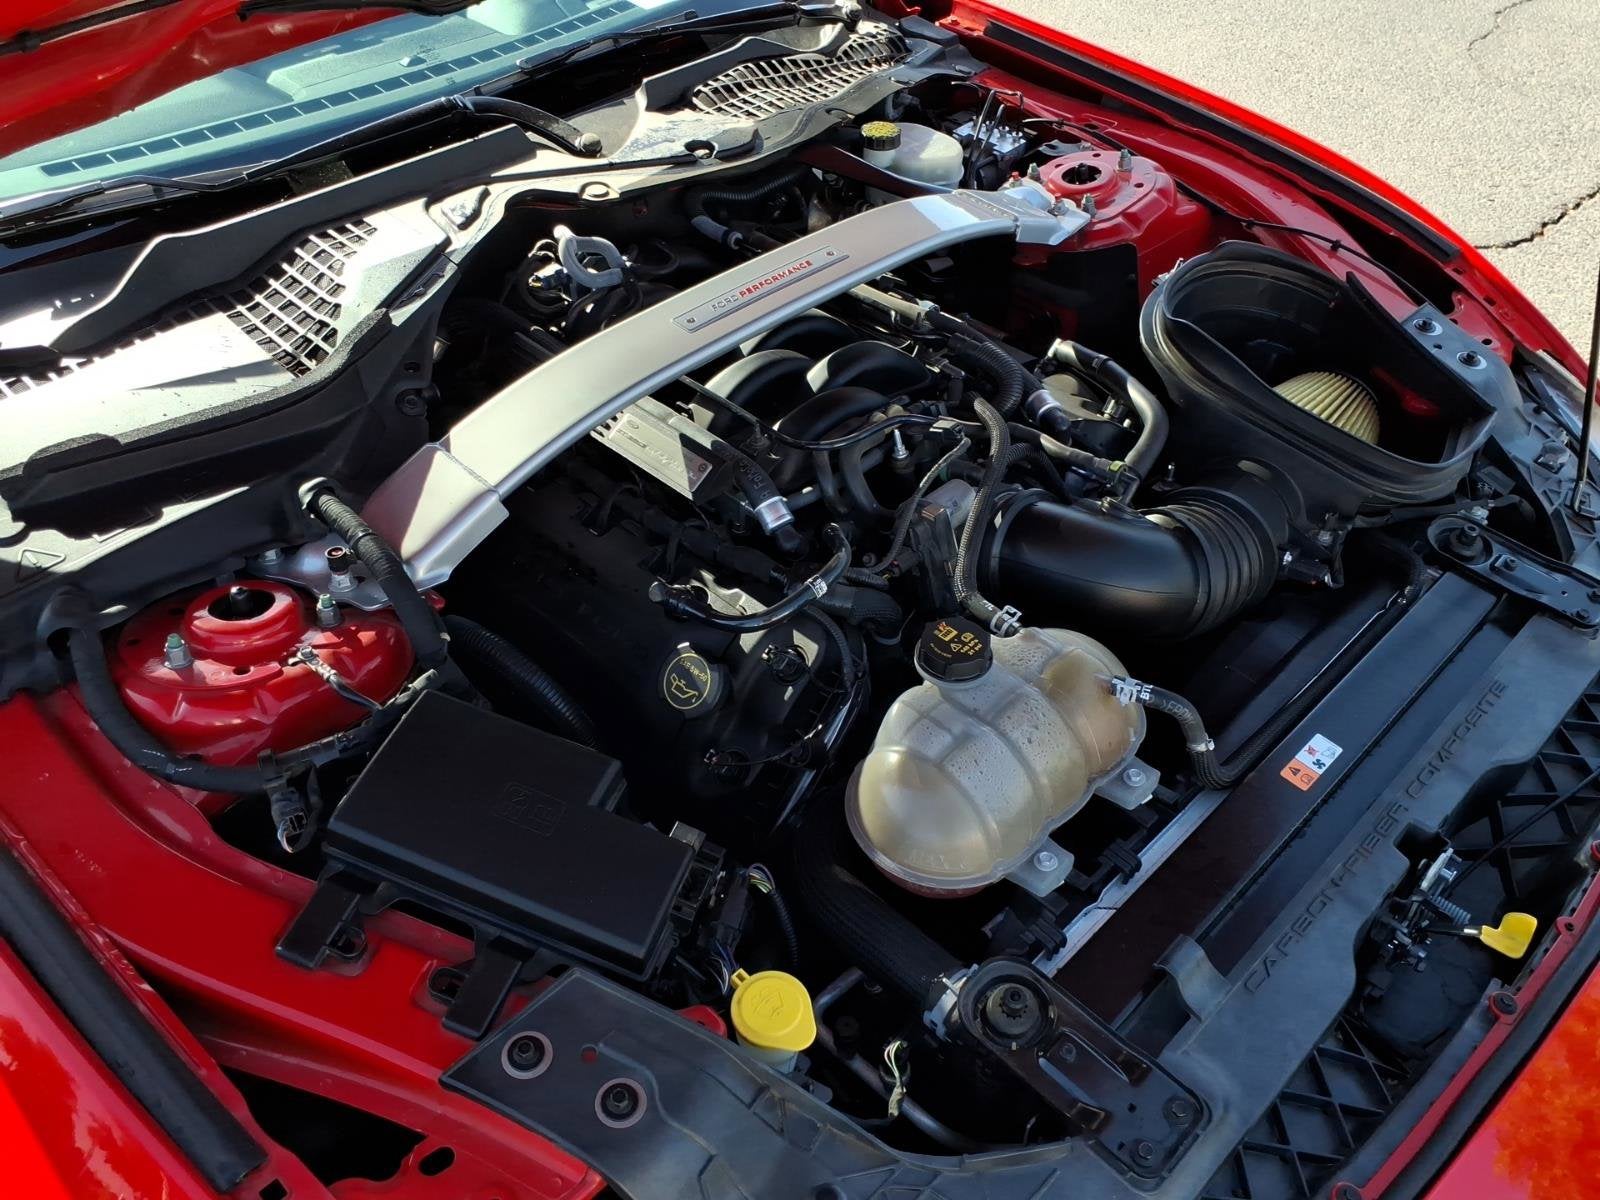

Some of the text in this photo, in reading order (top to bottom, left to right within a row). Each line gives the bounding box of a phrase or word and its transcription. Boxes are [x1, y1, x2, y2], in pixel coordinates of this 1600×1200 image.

[711, 260, 813, 312] FORD PERFORMANCE
[1407, 681, 1508, 798] COMPOSITE
